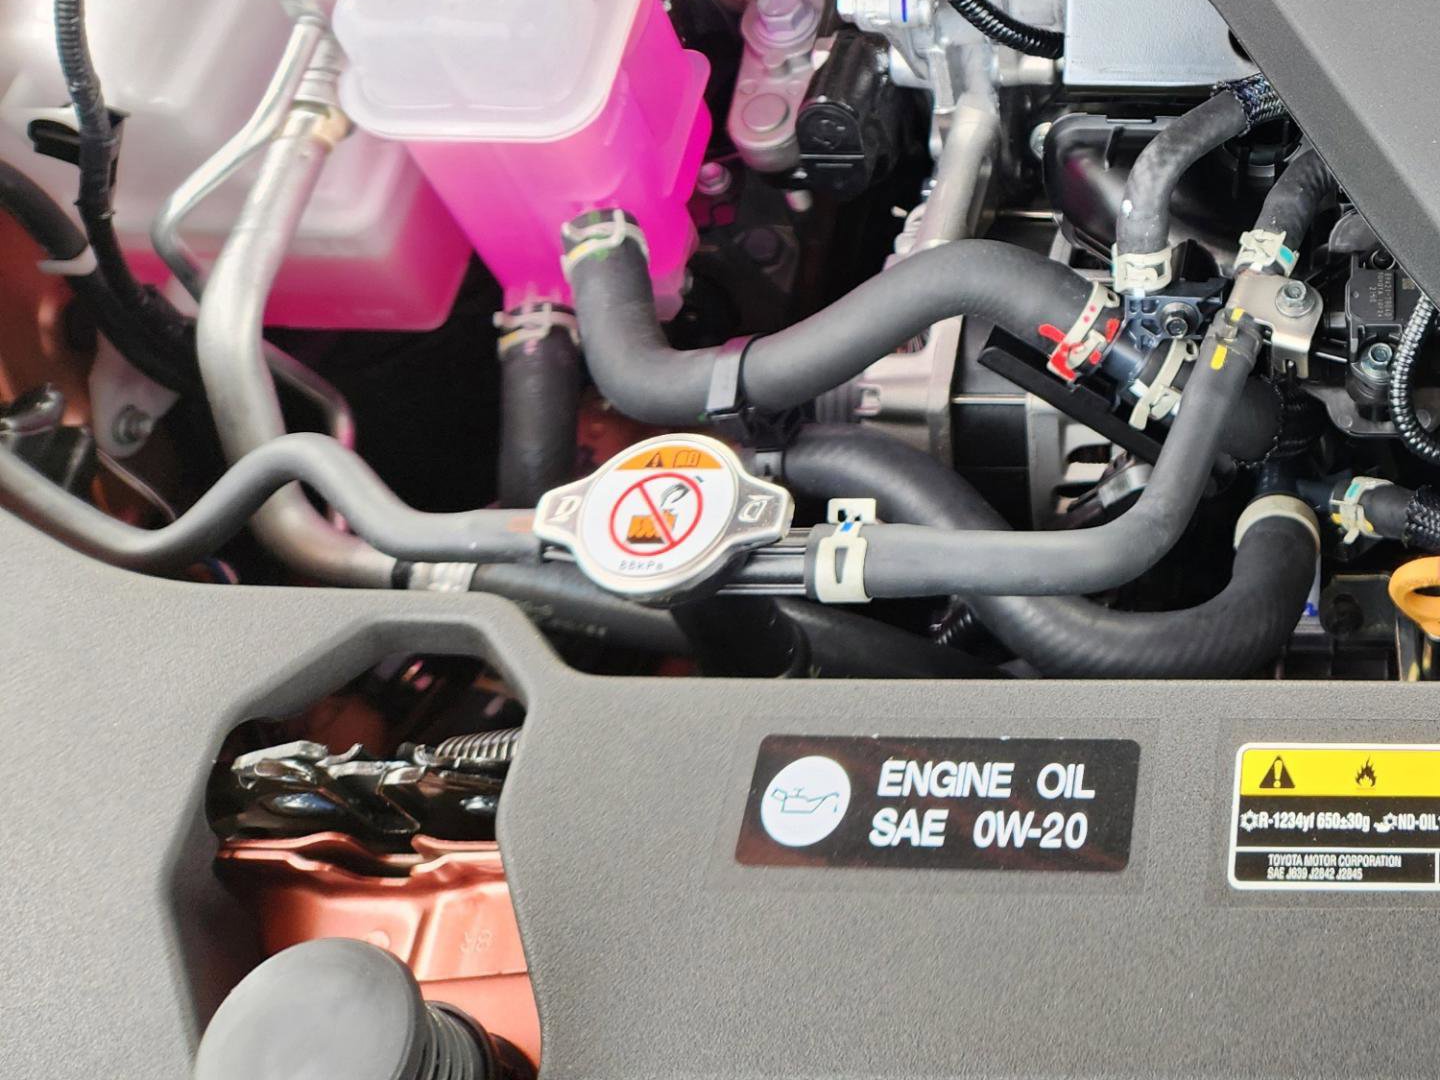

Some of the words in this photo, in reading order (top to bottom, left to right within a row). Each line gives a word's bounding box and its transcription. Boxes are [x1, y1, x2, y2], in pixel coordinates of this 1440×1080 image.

[876, 759, 1015, 798] ENGINE
[1036, 762, 1096, 800] OIL
[868, 807, 950, 847] SAE
[972, 809, 1089, 849] 0W-20
[1267, 853, 1303, 867] TOYOTA
[1303, 854, 1337, 868] MOTOR
[1337, 854, 1402, 868] CORPORATION
[1267, 866, 1285, 880] SAE
